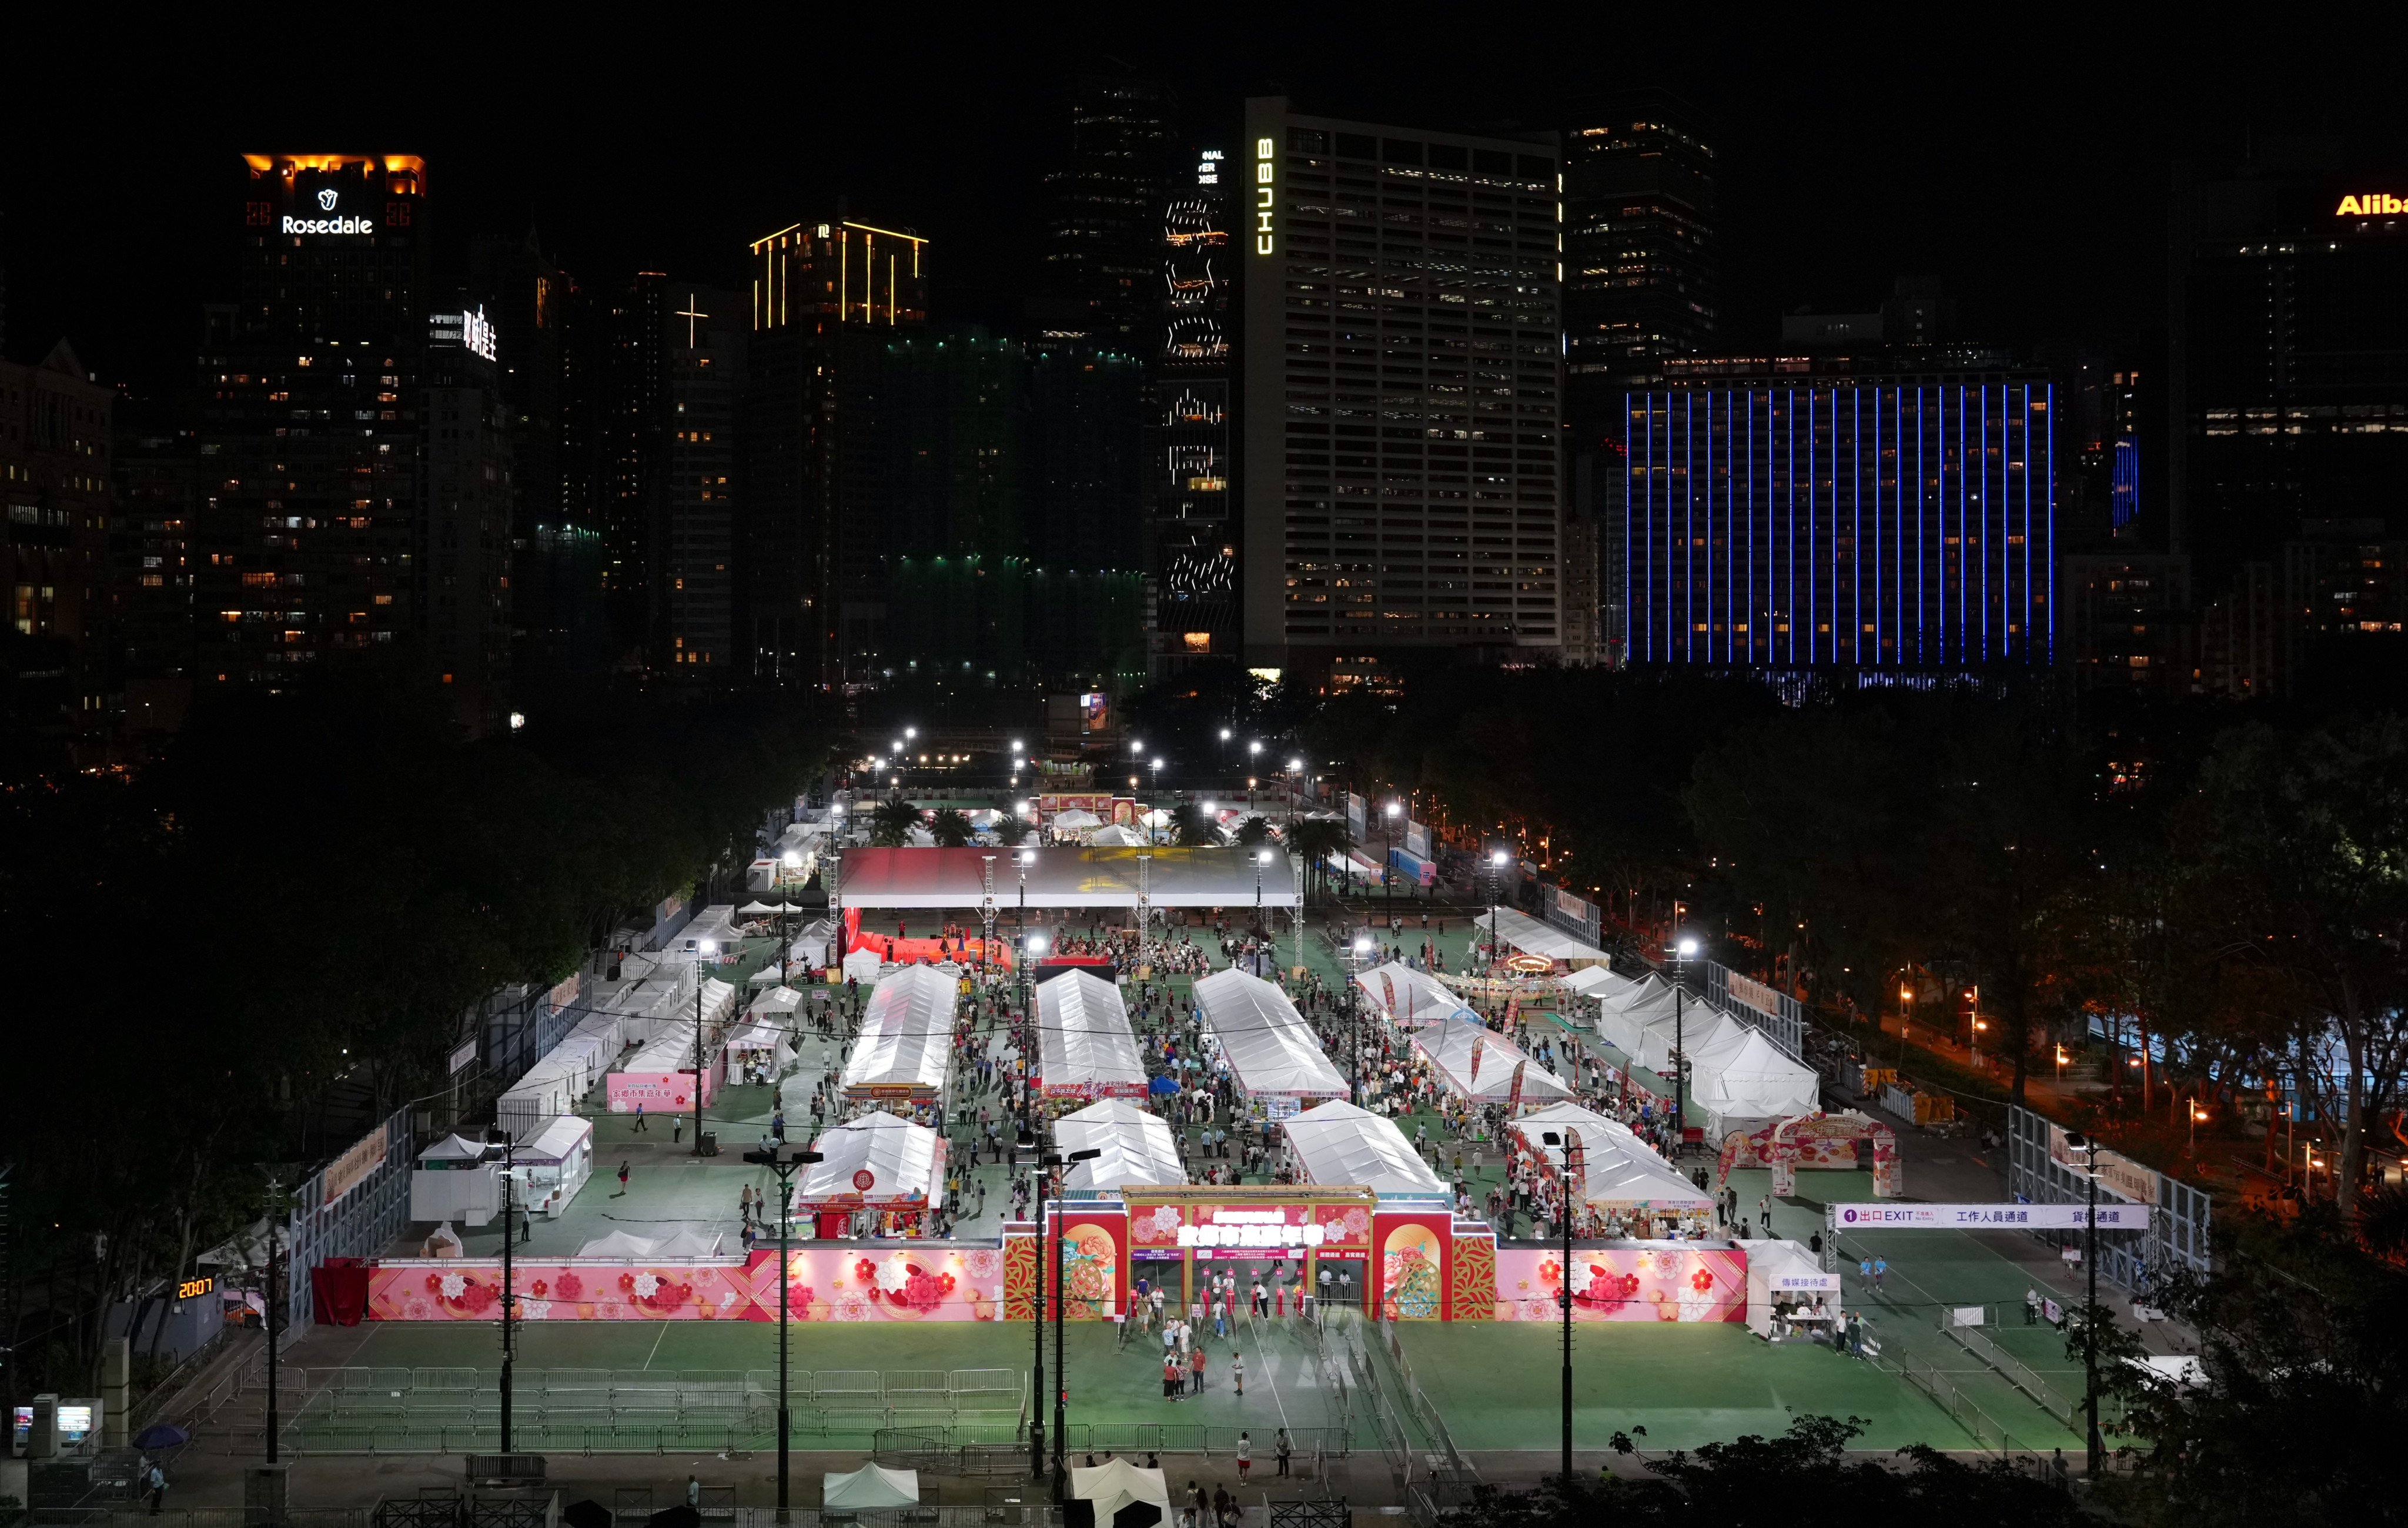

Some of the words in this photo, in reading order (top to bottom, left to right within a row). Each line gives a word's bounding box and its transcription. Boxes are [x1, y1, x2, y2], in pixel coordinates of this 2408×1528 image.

[1202, 151, 1224, 160] NAL
[1199, 163, 1215, 172] ER
[1258, 138, 1273, 254] CHUBB
[283, 216, 373, 234] Rosedale
[613, 1089, 672, 1098] 家鄉市集嘉年華
[1860, 1210, 1882, 1221] 出口
[1885, 1211, 1914, 1221] EXIT
[1956, 1211, 2028, 1223] 工作人員通道
[1782, 1278, 1828, 1287] 傳媒接待處
[179, 1278, 212, 1299] 20:07
